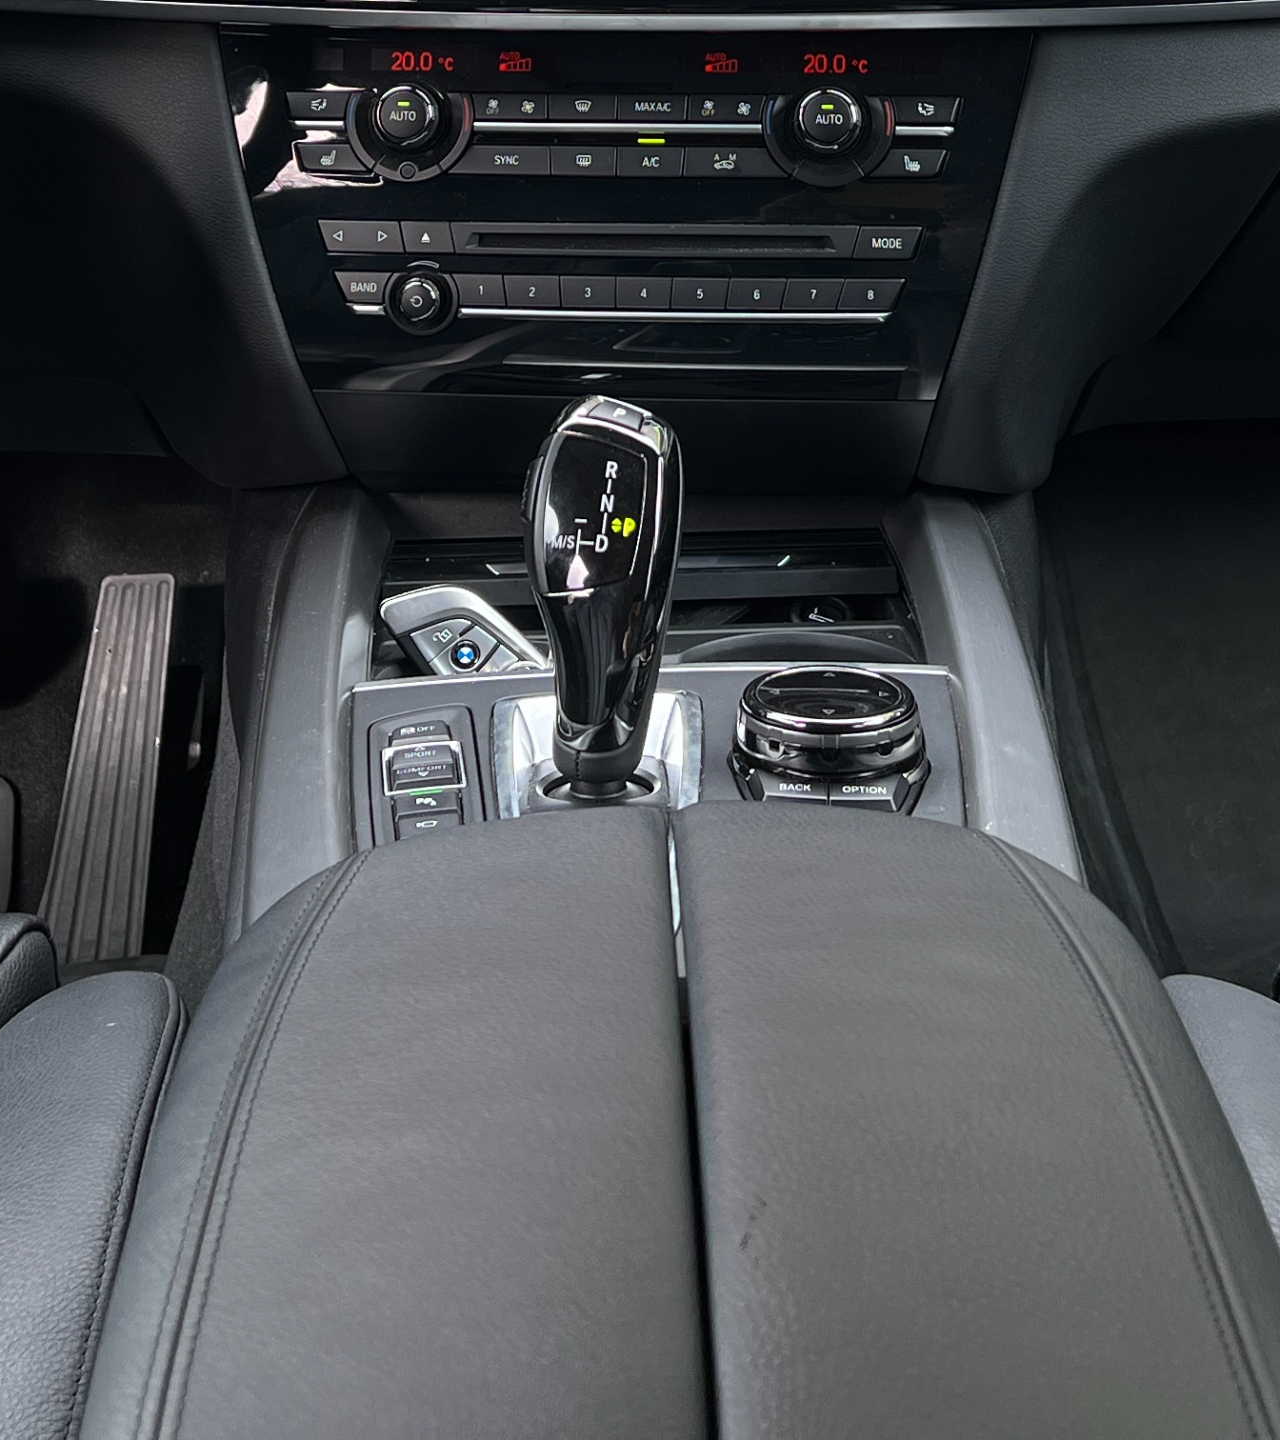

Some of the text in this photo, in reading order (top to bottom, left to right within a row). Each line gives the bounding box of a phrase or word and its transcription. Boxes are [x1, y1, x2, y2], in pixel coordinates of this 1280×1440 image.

[390, 51, 433, 71] 20.0
[499, 51, 520, 60] AUTO
[705, 52, 727, 61] AUTO
[803, 53, 847, 74] 20.0
[389, 110, 417, 122] AUTO
[485, 107, 500, 115] OFF
[701, 108, 715, 116] OFF
[815, 114, 843, 125] AUTO
[494, 155, 520, 166] SYNC
[642, 157, 660, 168] A/C
[871, 238, 903, 250] MODE
[350, 282, 377, 293] BAND
[478, 285, 484, 295] 1
[528, 286, 536, 297] 2
[584, 287, 592, 298] 3
[640, 287, 647, 298] 4
[696, 288, 704, 300] 5
[753, 289, 761, 300] 6
[810, 289, 817, 300] 7
[867, 289, 874, 300] 8
[612, 407, 627, 418] P
[605, 460, 619, 479] R
[599, 493, 615, 513] N
[622, 516, 636, 538] P
[550, 534, 575, 550] M/S
[594, 533, 609, 553] D
[416, 725, 436, 733] OFF
[404, 749, 437, 759] SPORT
[396, 764, 447, 775] COMFORT
[779, 783, 812, 792] BACK
[841, 785, 888, 795] OPTION
